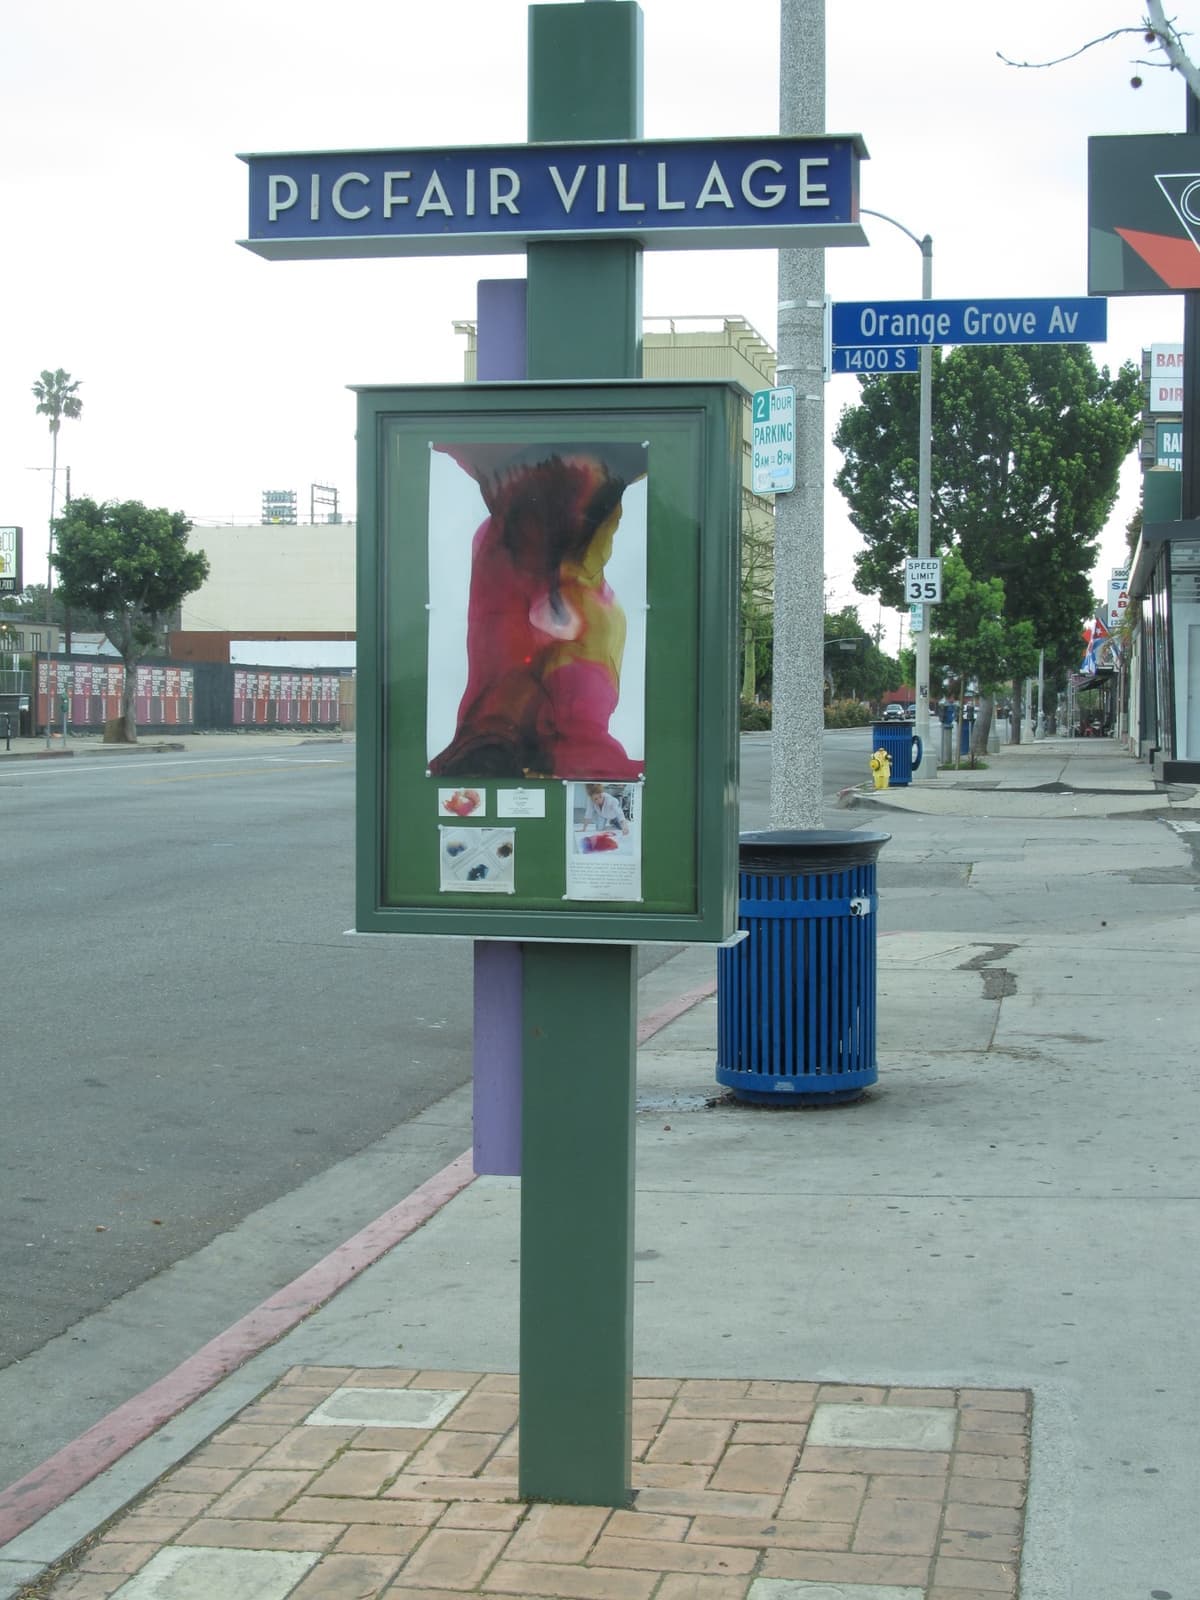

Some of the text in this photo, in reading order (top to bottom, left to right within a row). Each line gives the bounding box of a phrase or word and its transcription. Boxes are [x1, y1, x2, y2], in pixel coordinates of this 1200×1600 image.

[268, 158, 831, 221] PICFAIR VILLAGE
[860, 305, 1079, 343] Orange Grove Av
[843, 348, 906, 370] 1400 S
[757, 396, 792, 418] 2 HOUR
[754, 423, 792, 445] PARKING
[754, 453, 769, 468] 8AM
[777, 450, 792, 465] 8PM
[908, 562, 938, 570] SPEED
[911, 572, 935, 580] LIMIT
[909, 582, 937, 599] 35
